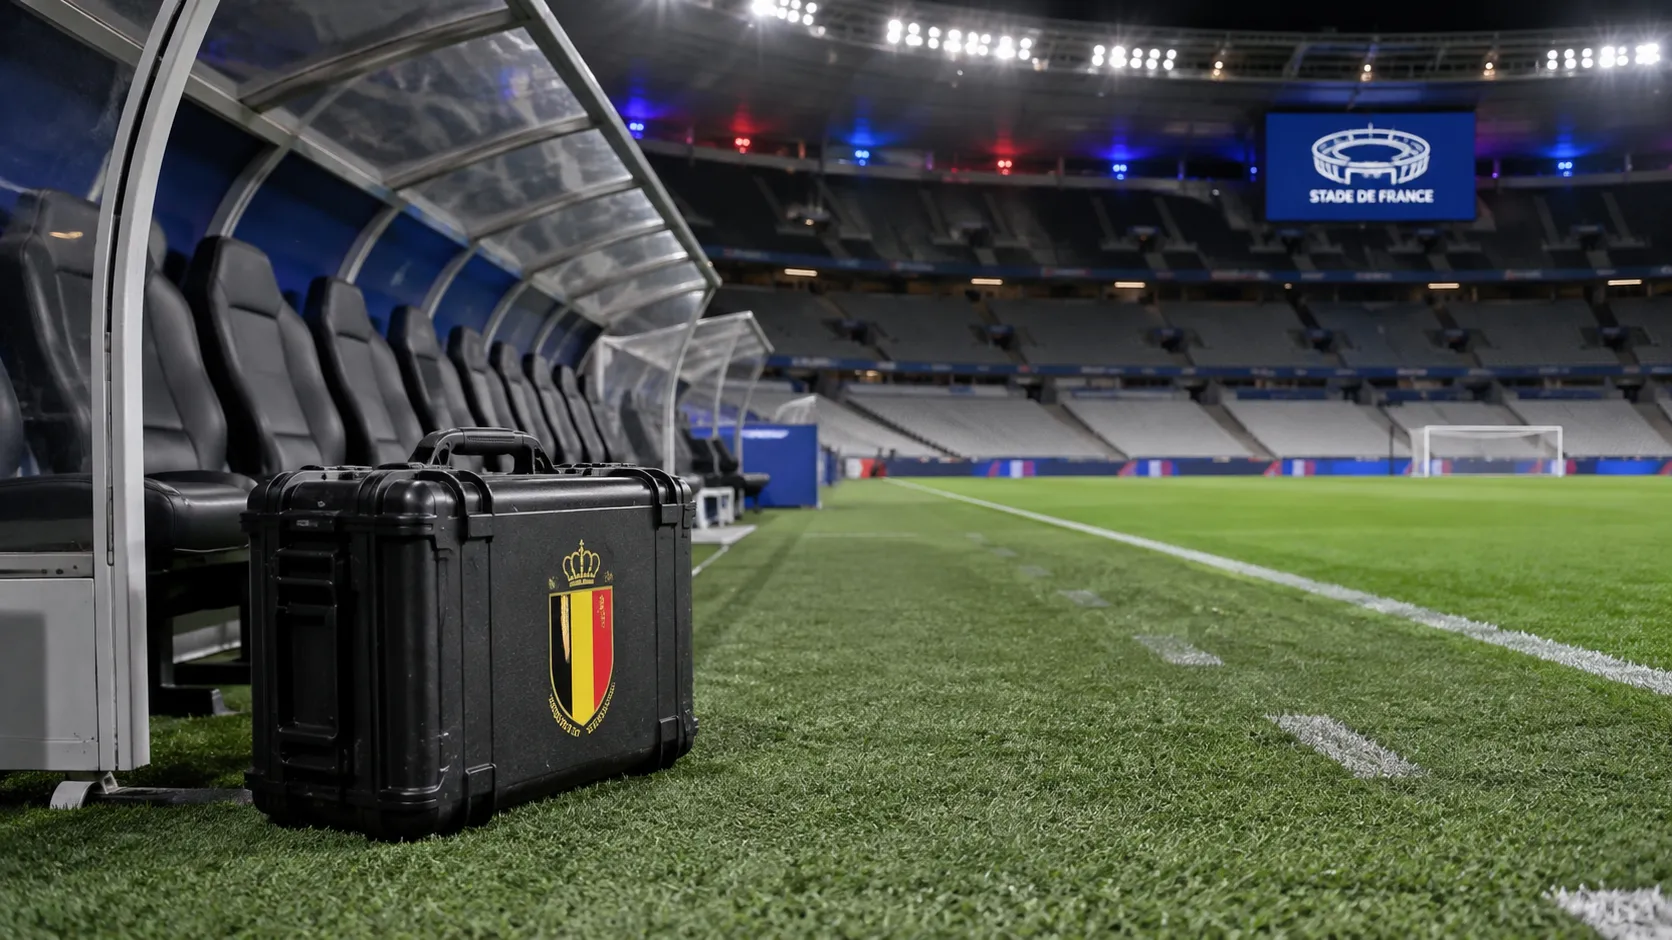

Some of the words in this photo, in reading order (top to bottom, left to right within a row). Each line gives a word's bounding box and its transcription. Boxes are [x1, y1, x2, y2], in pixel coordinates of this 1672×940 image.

[1309, 189, 1355, 203] STADE
[1356, 189, 1376, 203] DE
[1378, 189, 1434, 203] FRANCE
